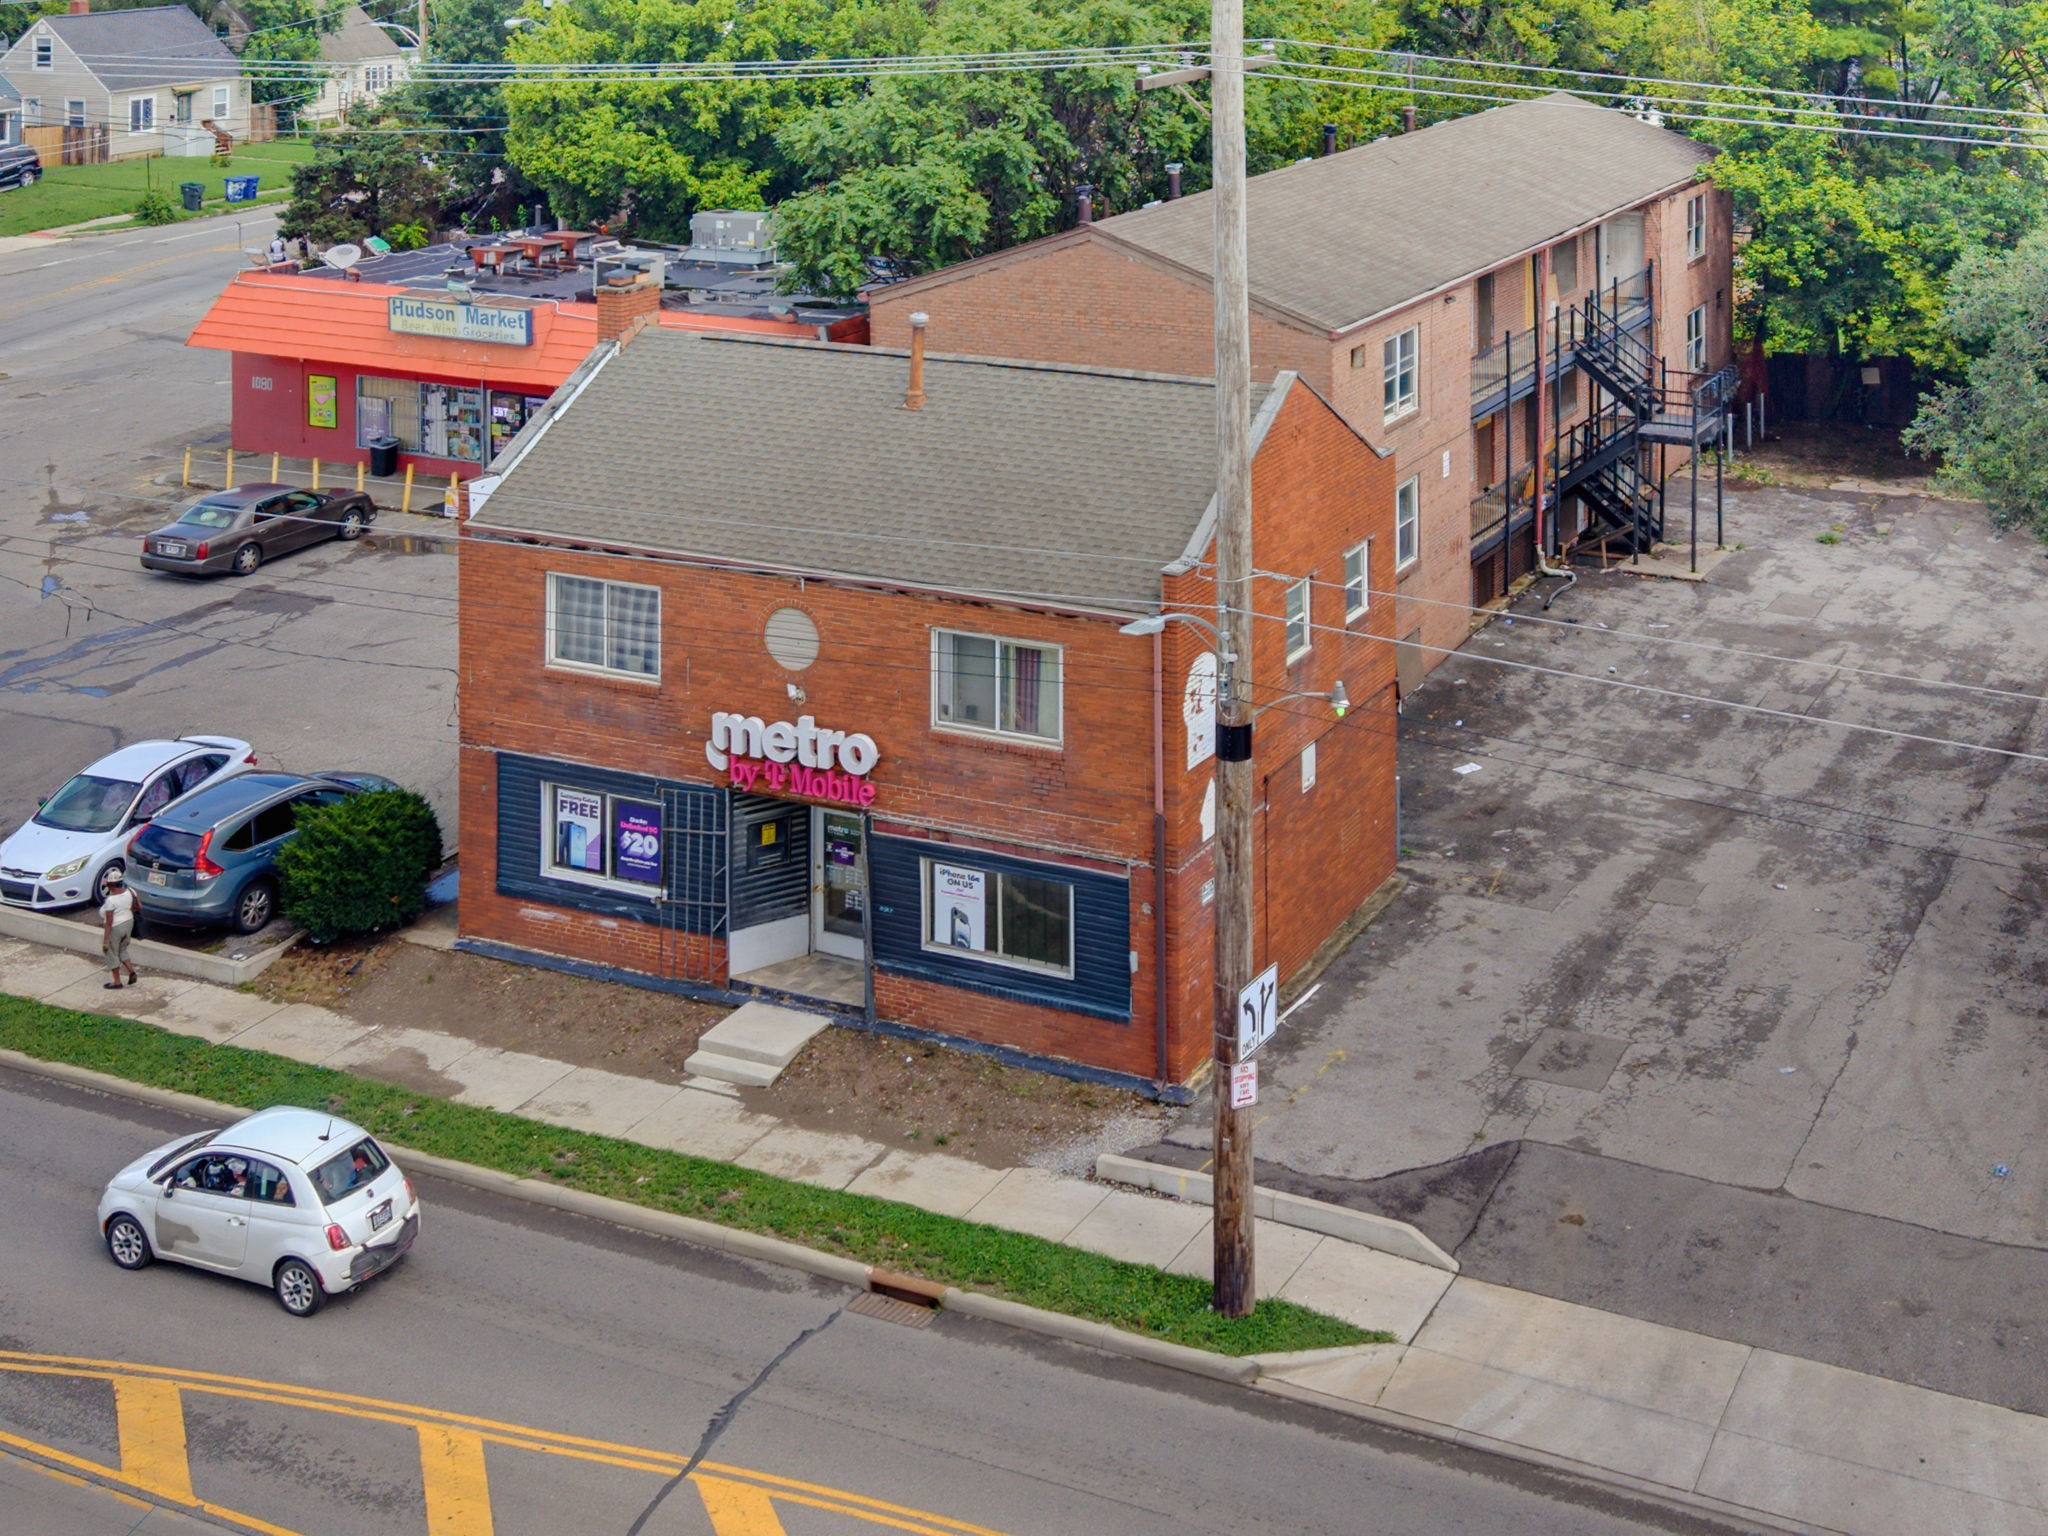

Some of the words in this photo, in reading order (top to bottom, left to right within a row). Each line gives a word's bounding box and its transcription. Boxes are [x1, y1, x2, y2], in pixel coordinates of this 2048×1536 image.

[392, 299, 455, 321] Hudson
[466, 307, 524, 329] Market
[463, 327, 515, 340] Groceries
[707, 711, 879, 775] metro
[729, 754, 760, 792] by
[560, 799, 599, 820] FREE
[620, 831, 659, 858] $20
[940, 867, 966, 880] iPhone
[947, 878, 961, 886] ON
[962, 881, 974, 889] US
[1241, 1034, 1257, 1055] ONLY
